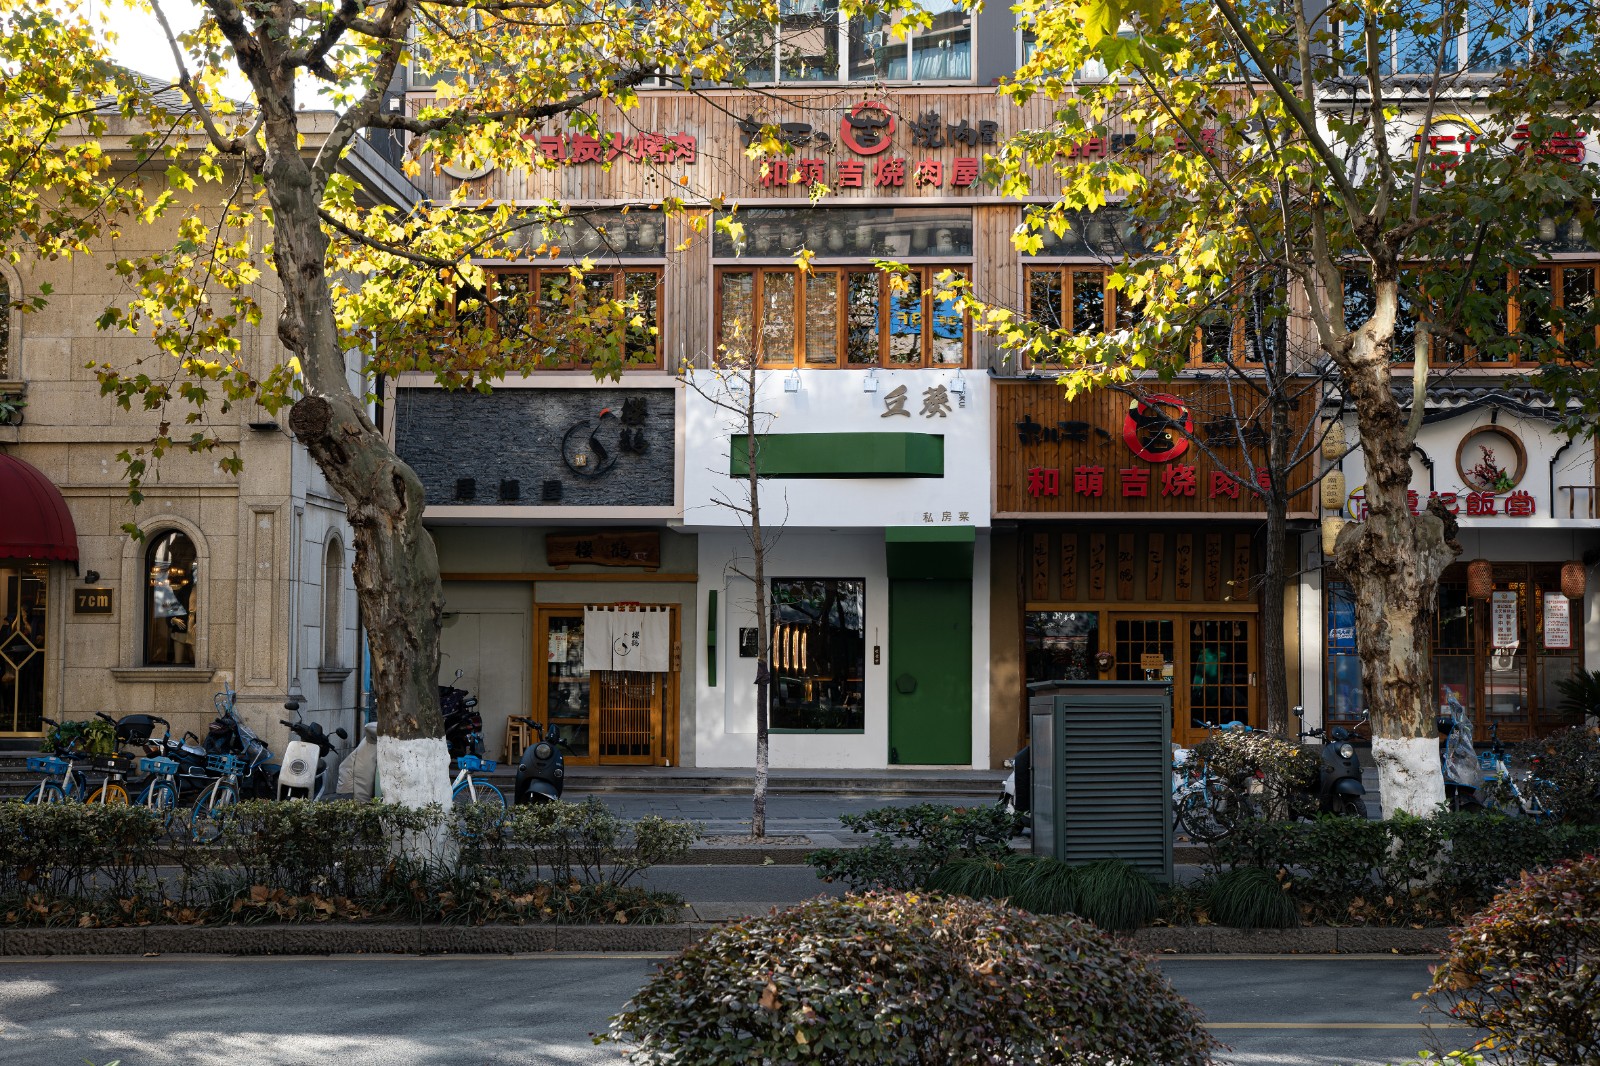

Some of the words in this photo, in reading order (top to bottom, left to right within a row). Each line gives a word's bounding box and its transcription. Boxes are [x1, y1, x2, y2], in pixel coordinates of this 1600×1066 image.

[737, 113, 830, 150] ホモン
[758, 157, 979, 188] 和萌吉烧肉屋
[922, 511, 970, 523] 私房菜
[79, 595, 109, 607] 7cm
